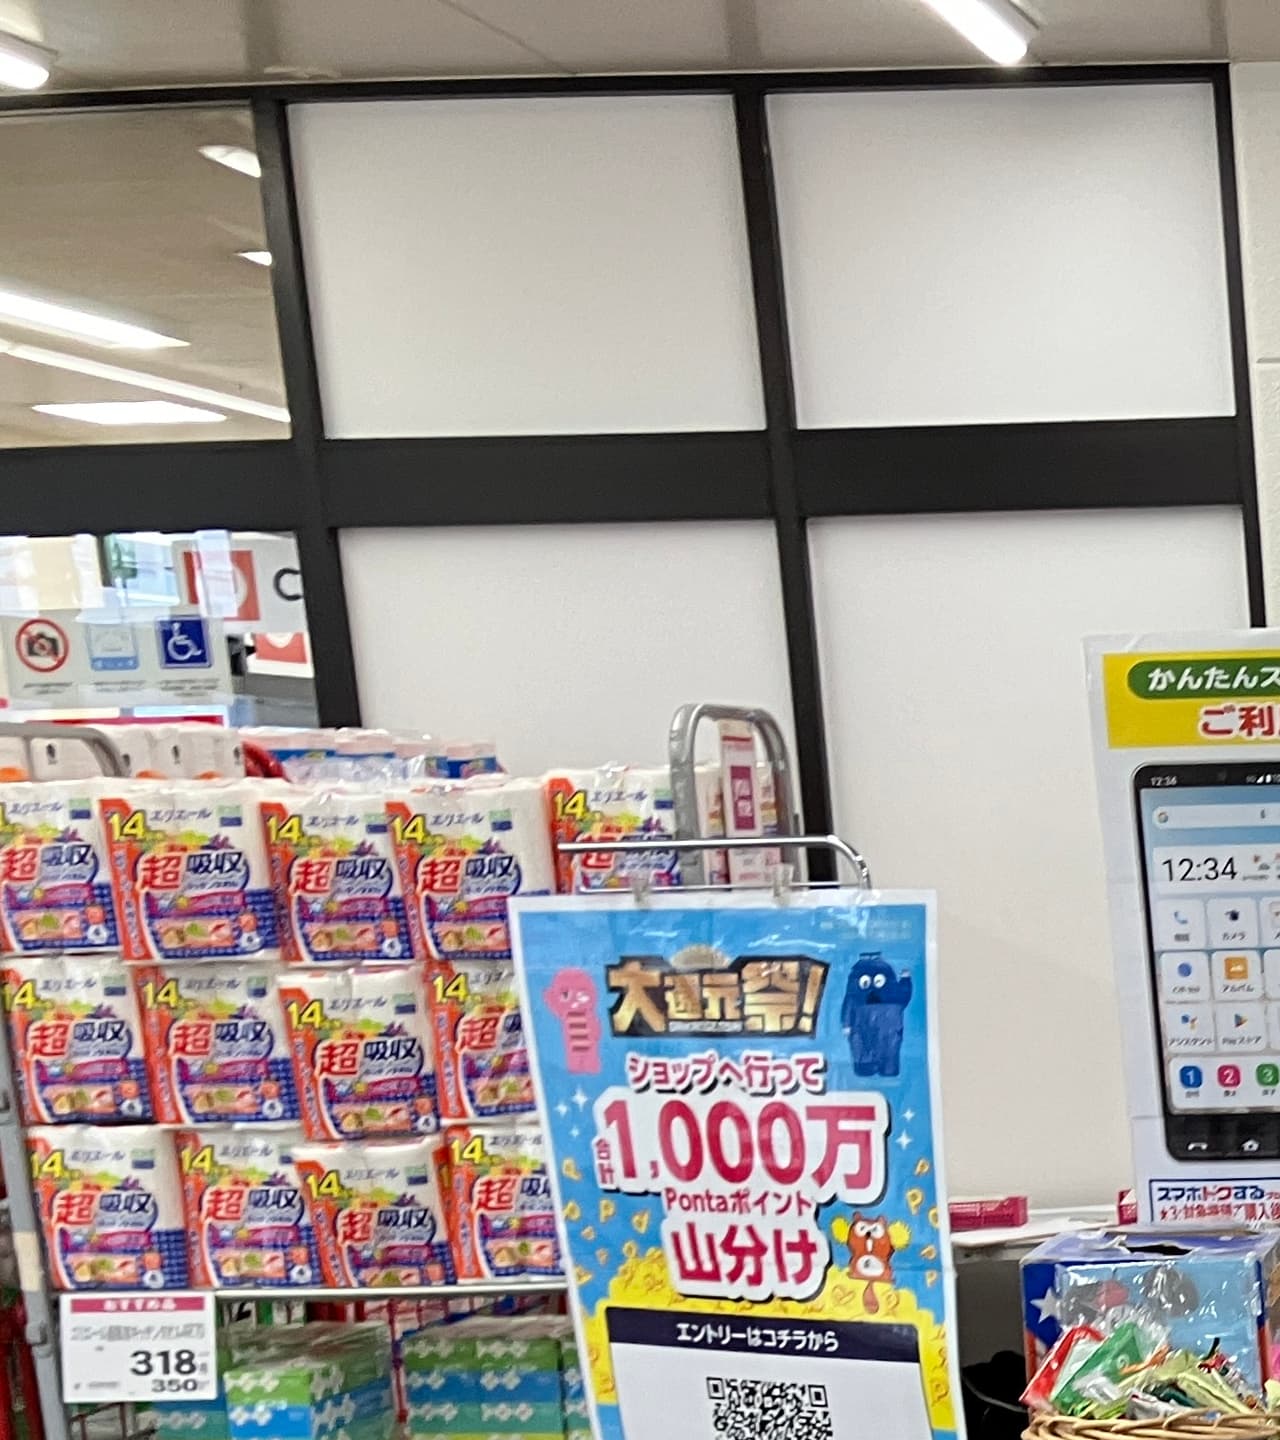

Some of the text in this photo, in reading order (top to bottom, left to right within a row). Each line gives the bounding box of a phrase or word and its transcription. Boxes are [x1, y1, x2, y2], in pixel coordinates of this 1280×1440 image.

[553, 789, 592, 822] 14
[108, 809, 146, 842] 14
[266, 814, 305, 845] 14
[392, 814, 428, 845] 14
[140, 849, 244, 891] 超吸収
[291, 856, 387, 894] 超吸収
[419, 855, 515, 894] 超吸収
[1162, 856, 1238, 883] 12:34
[144, 977, 180, 1009] 14
[434, 972, 471, 1003] 14
[286, 999, 326, 1032] 14
[29, 1019, 126, 1058] 超吸収
[170, 1019, 267, 1058] 超吸収
[459, 1013, 522, 1051] 超吸
[316, 1036, 418, 1077] 超吸収
[628, 1052, 824, 1092] ショップへ行って
[1185, 1069, 1197, 1085] 1
[1224, 1069, 1236, 1084] 2
[1262, 1066, 1275, 1082] 3
[182, 1144, 216, 1174] 14
[451, 1134, 487, 1166] 14
[604, 1099, 877, 1191] 1,000万
[31, 1151, 65, 1179] 14
[305, 1170, 342, 1198] 14
[1157, 1184, 1265, 1201] スマホトクする
[53, 1190, 153, 1227] 超吸収
[204, 1187, 300, 1222] 超吸収
[665, 1187, 814, 1217] Pontaポイント
[338, 1207, 431, 1245] 超吸収
[671, 1223, 819, 1287] 山分け
[676, 1322, 840, 1353] エントリーはコチラから
[130, 1349, 197, 1376] 318
[151, 1378, 198, 1393] 350
